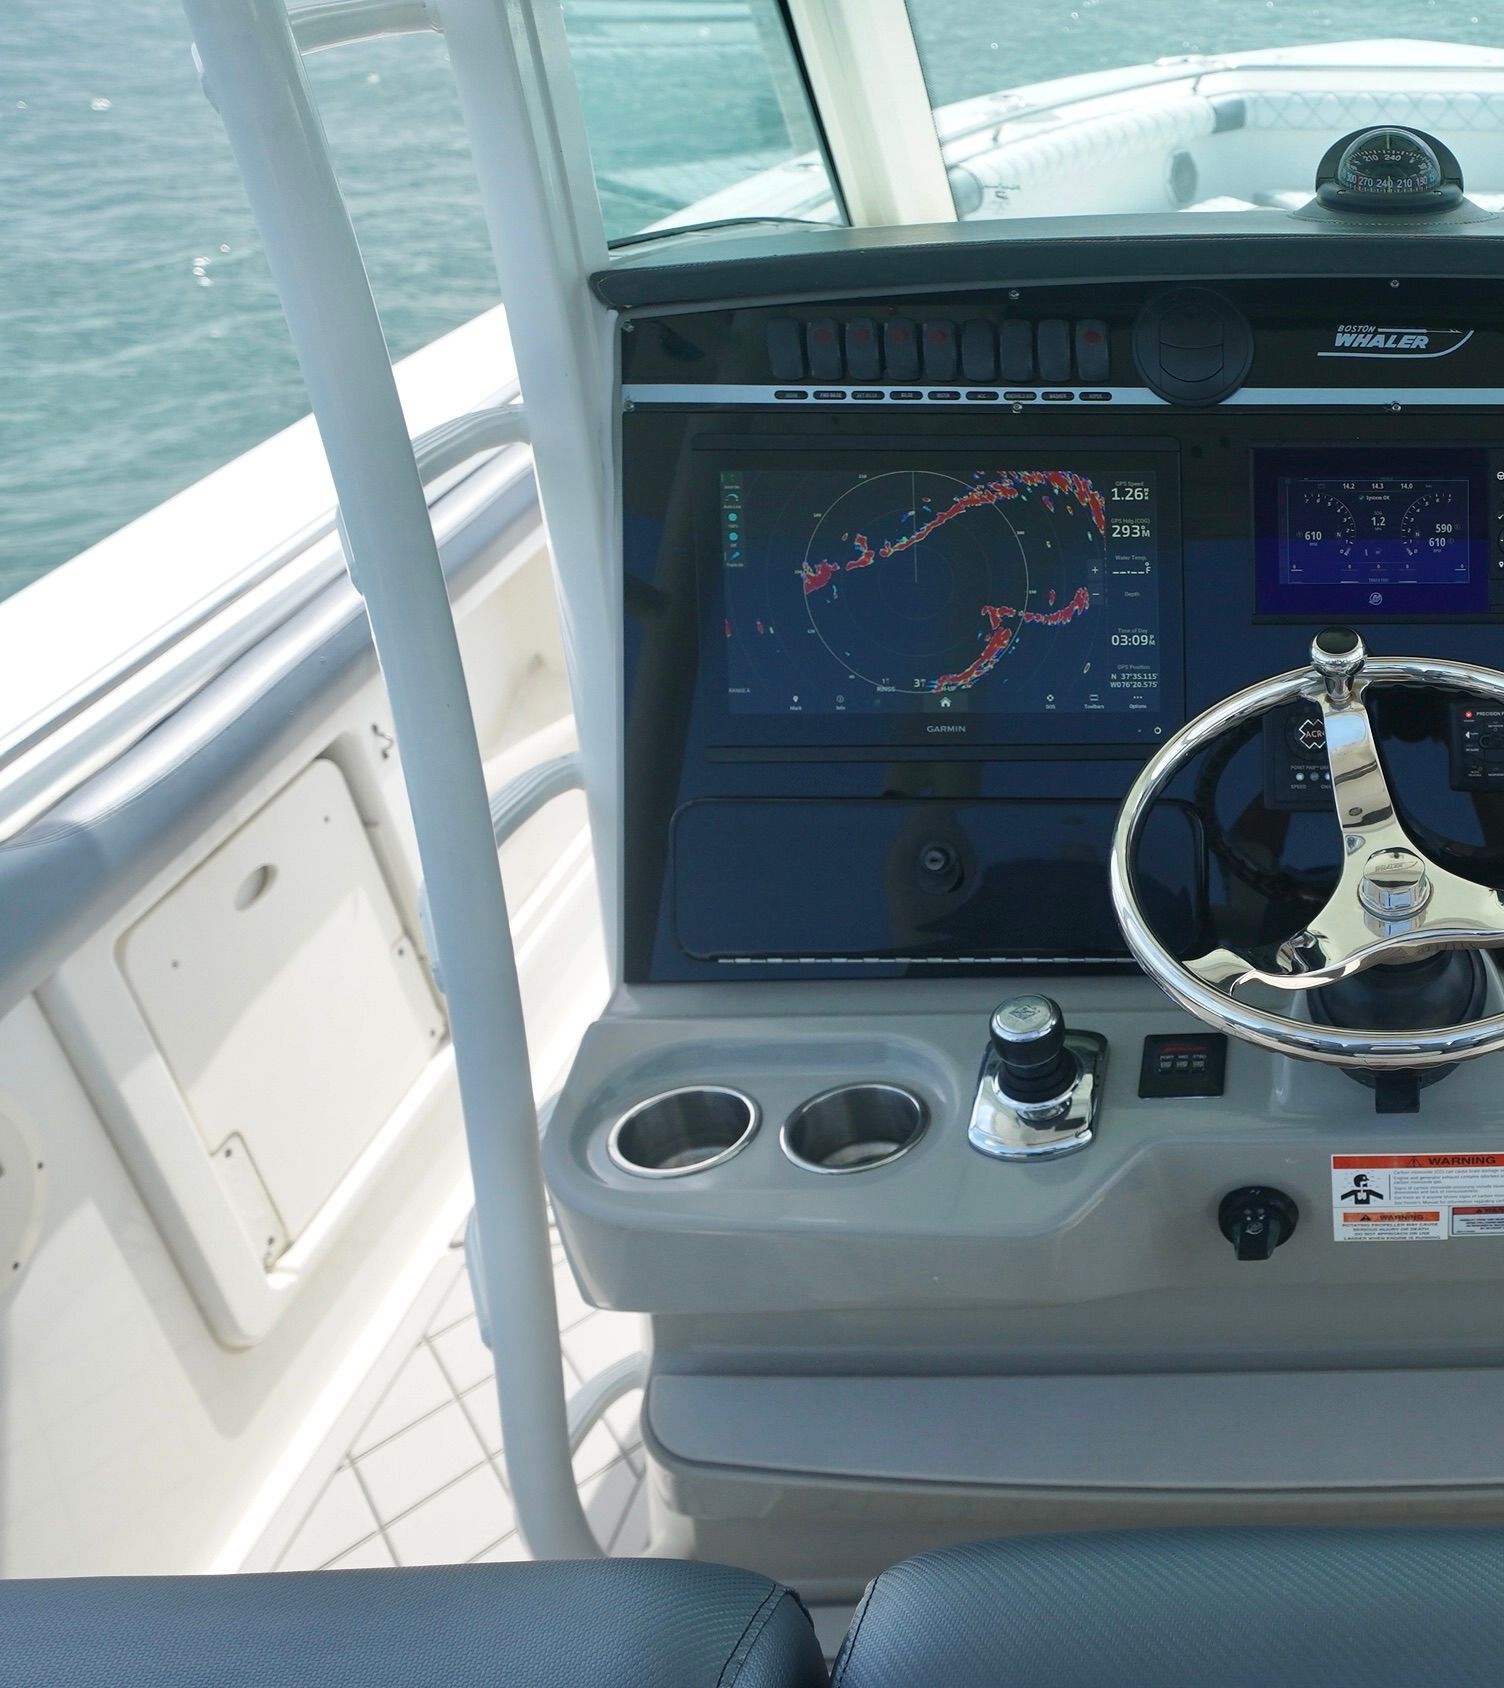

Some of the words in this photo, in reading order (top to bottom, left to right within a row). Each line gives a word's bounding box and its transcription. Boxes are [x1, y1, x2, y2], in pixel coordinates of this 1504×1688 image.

[1384, 154, 1402, 162] 240
[1376, 179, 1393, 188] 240
[1397, 180, 1413, 188] 210
[1337, 325, 1376, 334] BOSTON
[1334, 333, 1429, 349] WHALER
[1111, 487, 1144, 501] 1.26
[1371, 517, 1386, 527] 1.2
[1111, 525, 1141, 537] 293
[1436, 524, 1453, 533] 590
[1304, 531, 1322, 540] 610
[1429, 538, 1446, 547] 610
[1111, 635, 1149, 646] 03:09
[927, 725, 966, 733] GARMIN
[1428, 1156, 1496, 1165] WARNING
